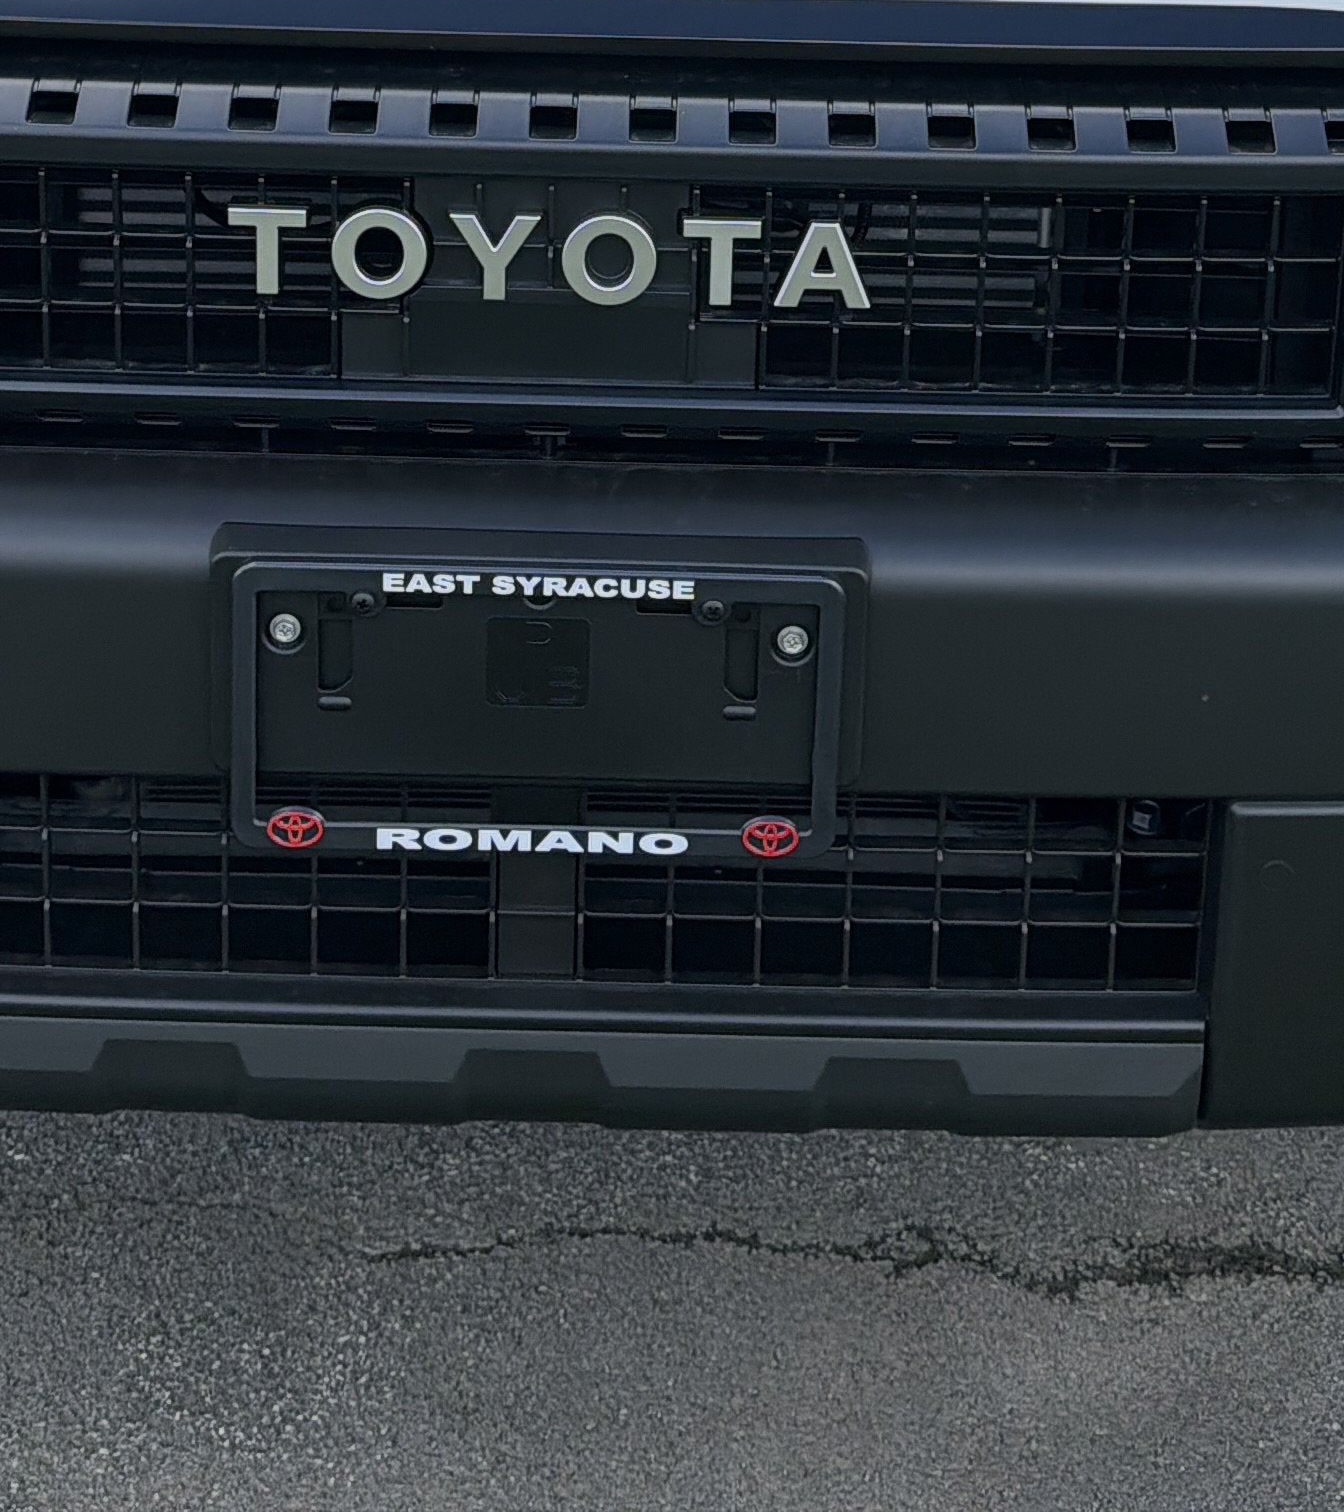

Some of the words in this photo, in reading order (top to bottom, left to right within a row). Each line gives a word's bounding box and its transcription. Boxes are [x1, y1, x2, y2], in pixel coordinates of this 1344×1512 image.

[227, 204, 871, 310] TOYOTA
[381, 573, 481, 595] EAST
[491, 574, 696, 601] SYRACUSE
[375, 826, 690, 856] ROMANO
